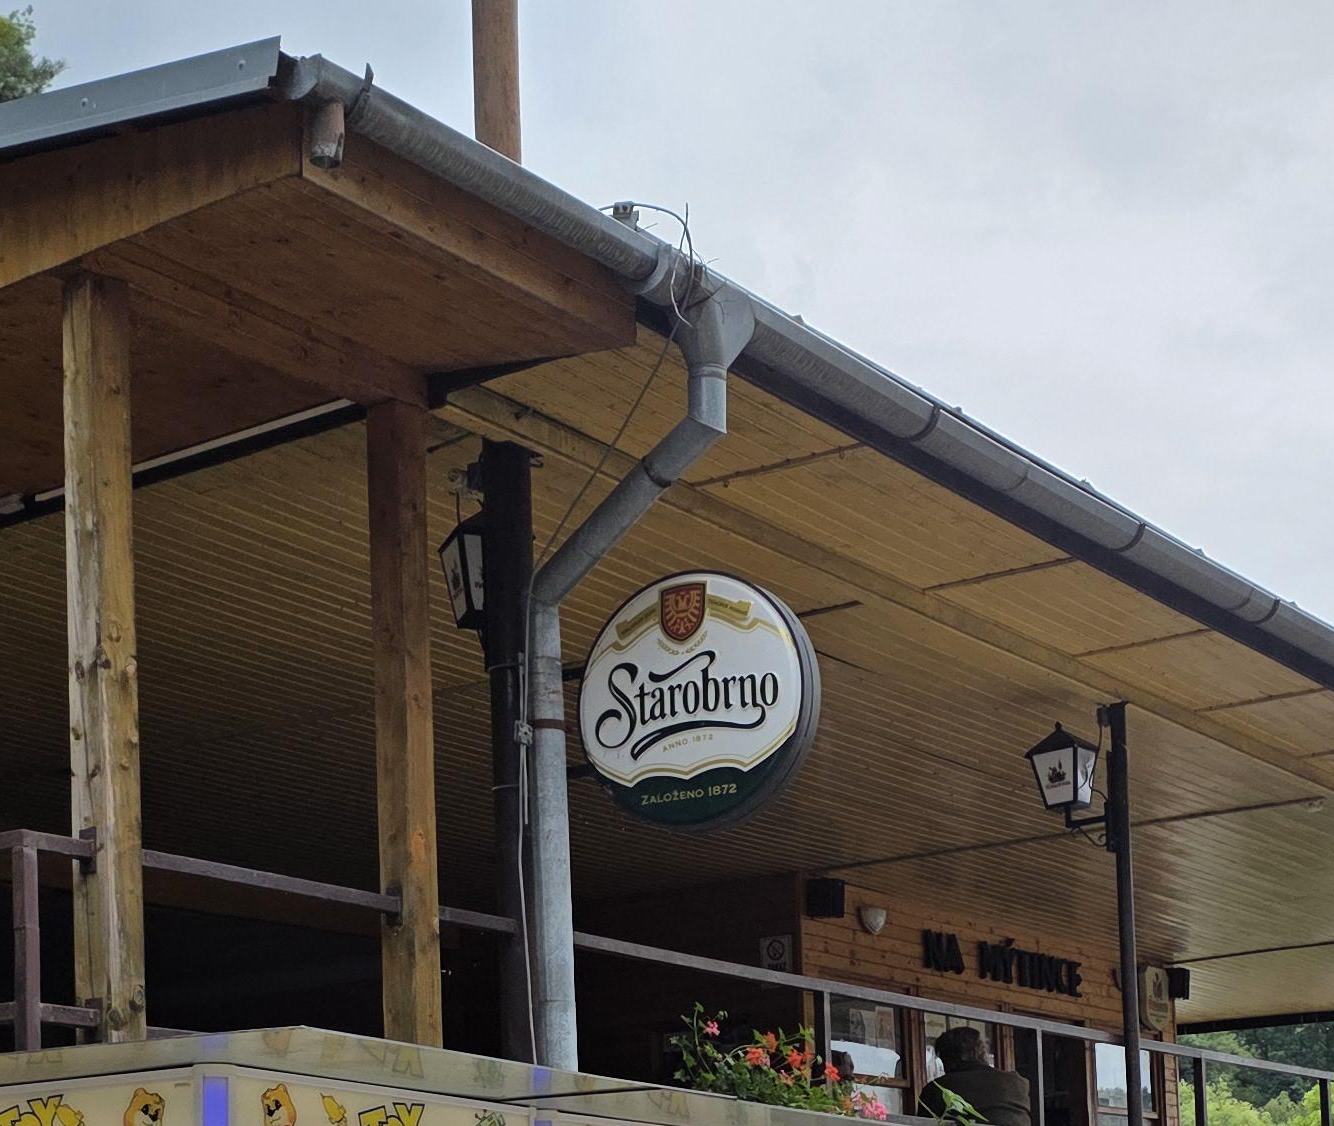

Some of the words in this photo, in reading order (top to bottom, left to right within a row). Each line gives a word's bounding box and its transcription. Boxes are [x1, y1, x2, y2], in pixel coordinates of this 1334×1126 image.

[595, 650, 779, 761] Starobrno
[662, 738, 688, 752] ANNO
[692, 733, 714, 743] 1872
[641, 787, 704, 805] ZALOŽENO
[708, 783, 737, 797] 1872
[921, 929, 965, 974] NA
